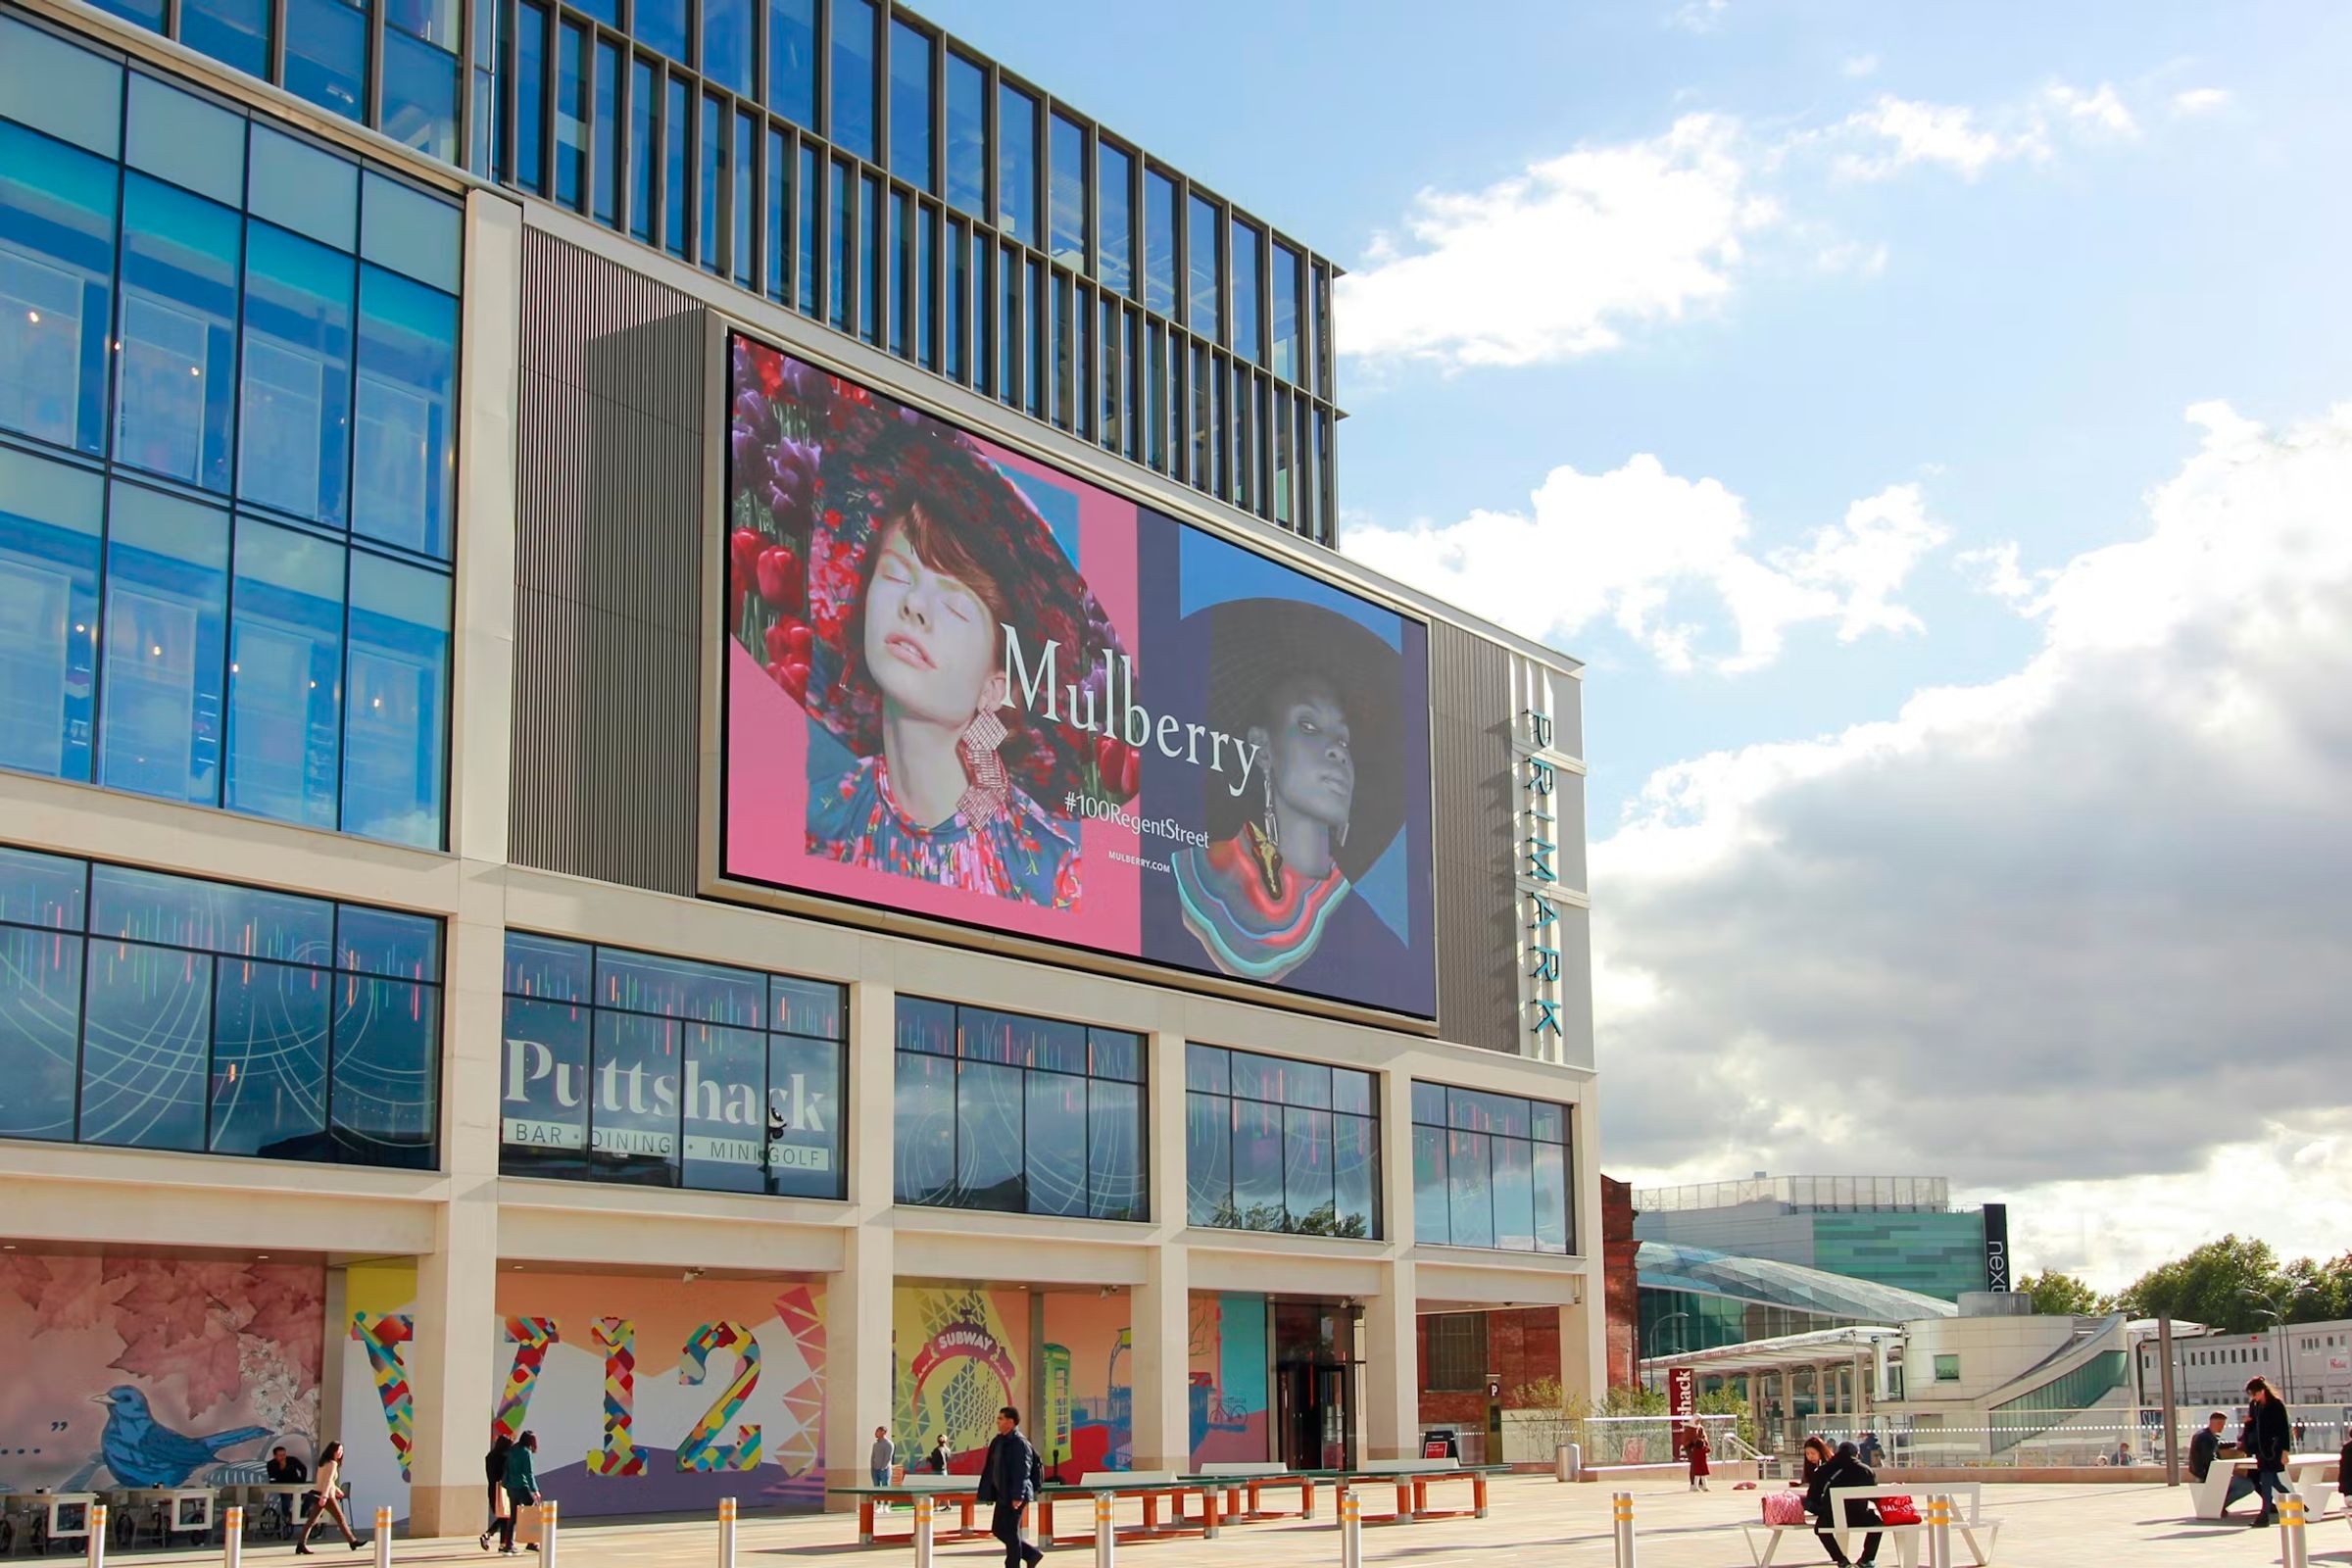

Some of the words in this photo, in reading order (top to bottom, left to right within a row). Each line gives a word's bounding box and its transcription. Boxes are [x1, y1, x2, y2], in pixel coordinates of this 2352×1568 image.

[1000, 621, 1261, 798] Mulberry
[1063, 791, 1210, 850] #100RegentStreet
[1107, 850, 1171, 874] MULBERRY.COM
[1526, 708, 1563, 1039] PRIMARK
[503, 1039, 826, 1133] Puttshack
[515, 1123, 563, 1146] BAR
[591, 1129, 671, 1154] DINING
[710, 1141, 758, 1161] MINI
[768, 1147, 819, 1167] GOLF
[1987, 1241, 2006, 1293] next
[938, 1330, 994, 1351] SUBWAY
[1491, 1385, 1498, 1396] P
